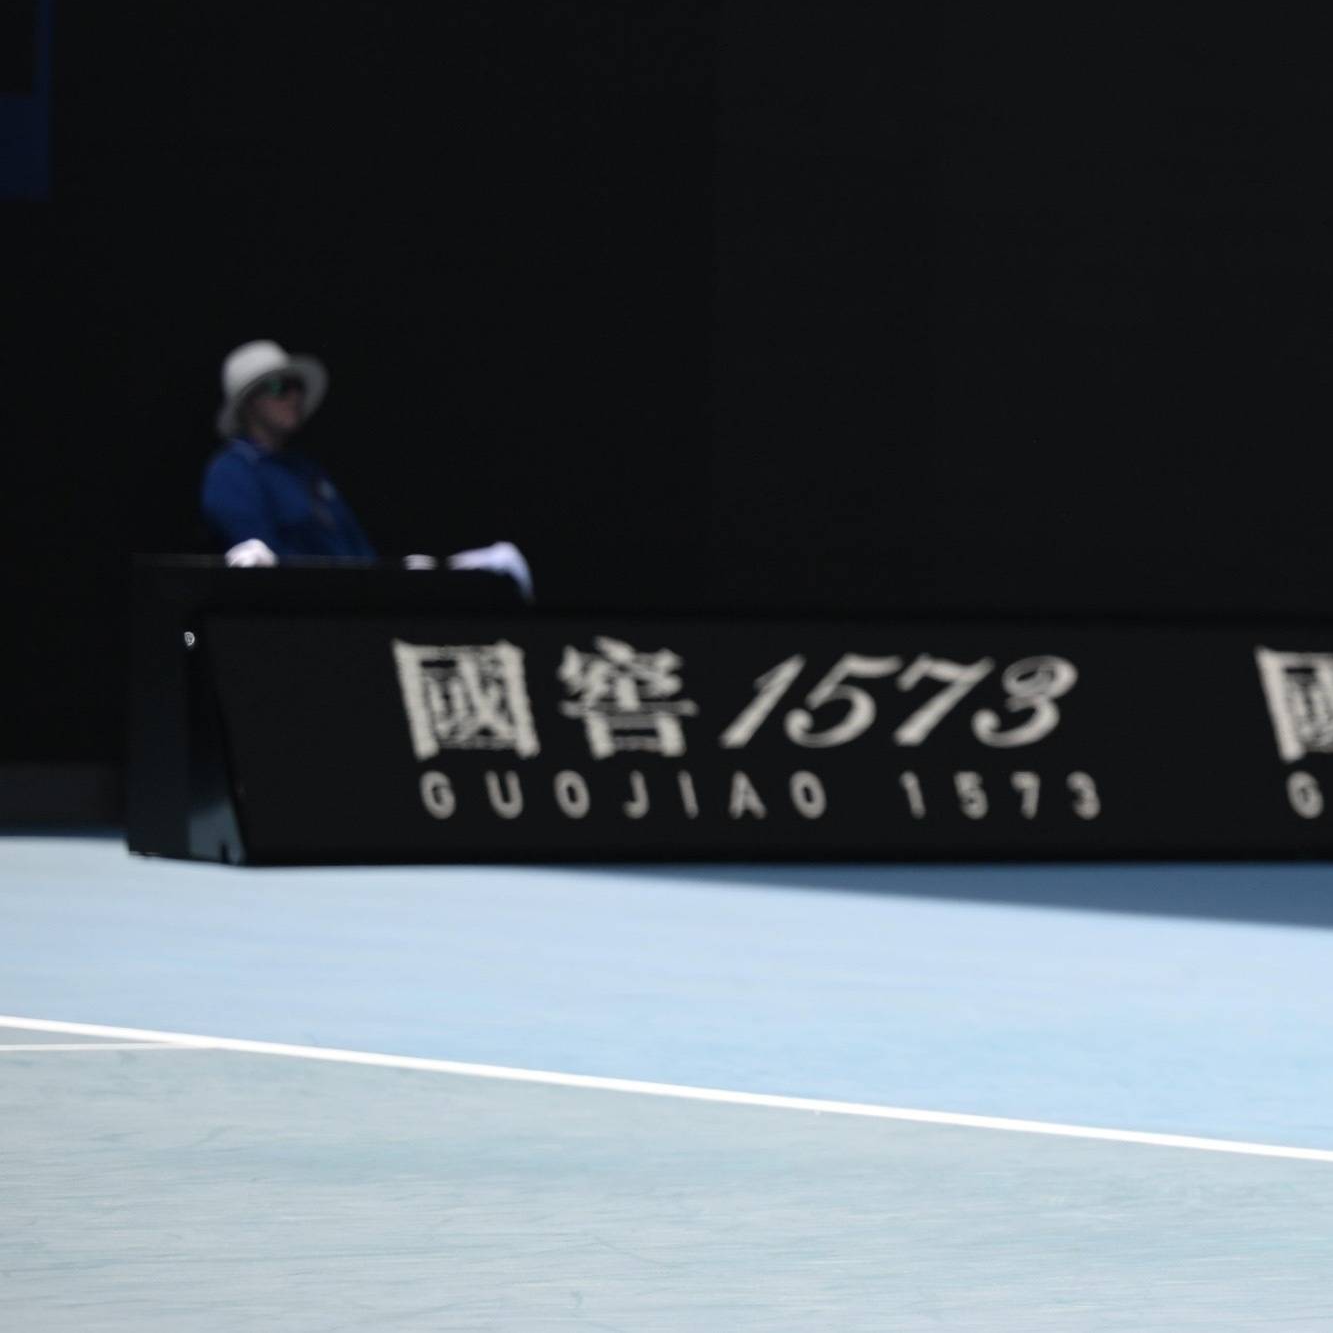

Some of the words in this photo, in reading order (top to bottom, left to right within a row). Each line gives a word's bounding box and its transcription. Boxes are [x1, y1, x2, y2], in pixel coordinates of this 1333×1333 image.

[720, 653, 1080, 749] 1573
[419, 769, 828, 820] GUOJIAO
[900, 770, 1101, 820] 1573
